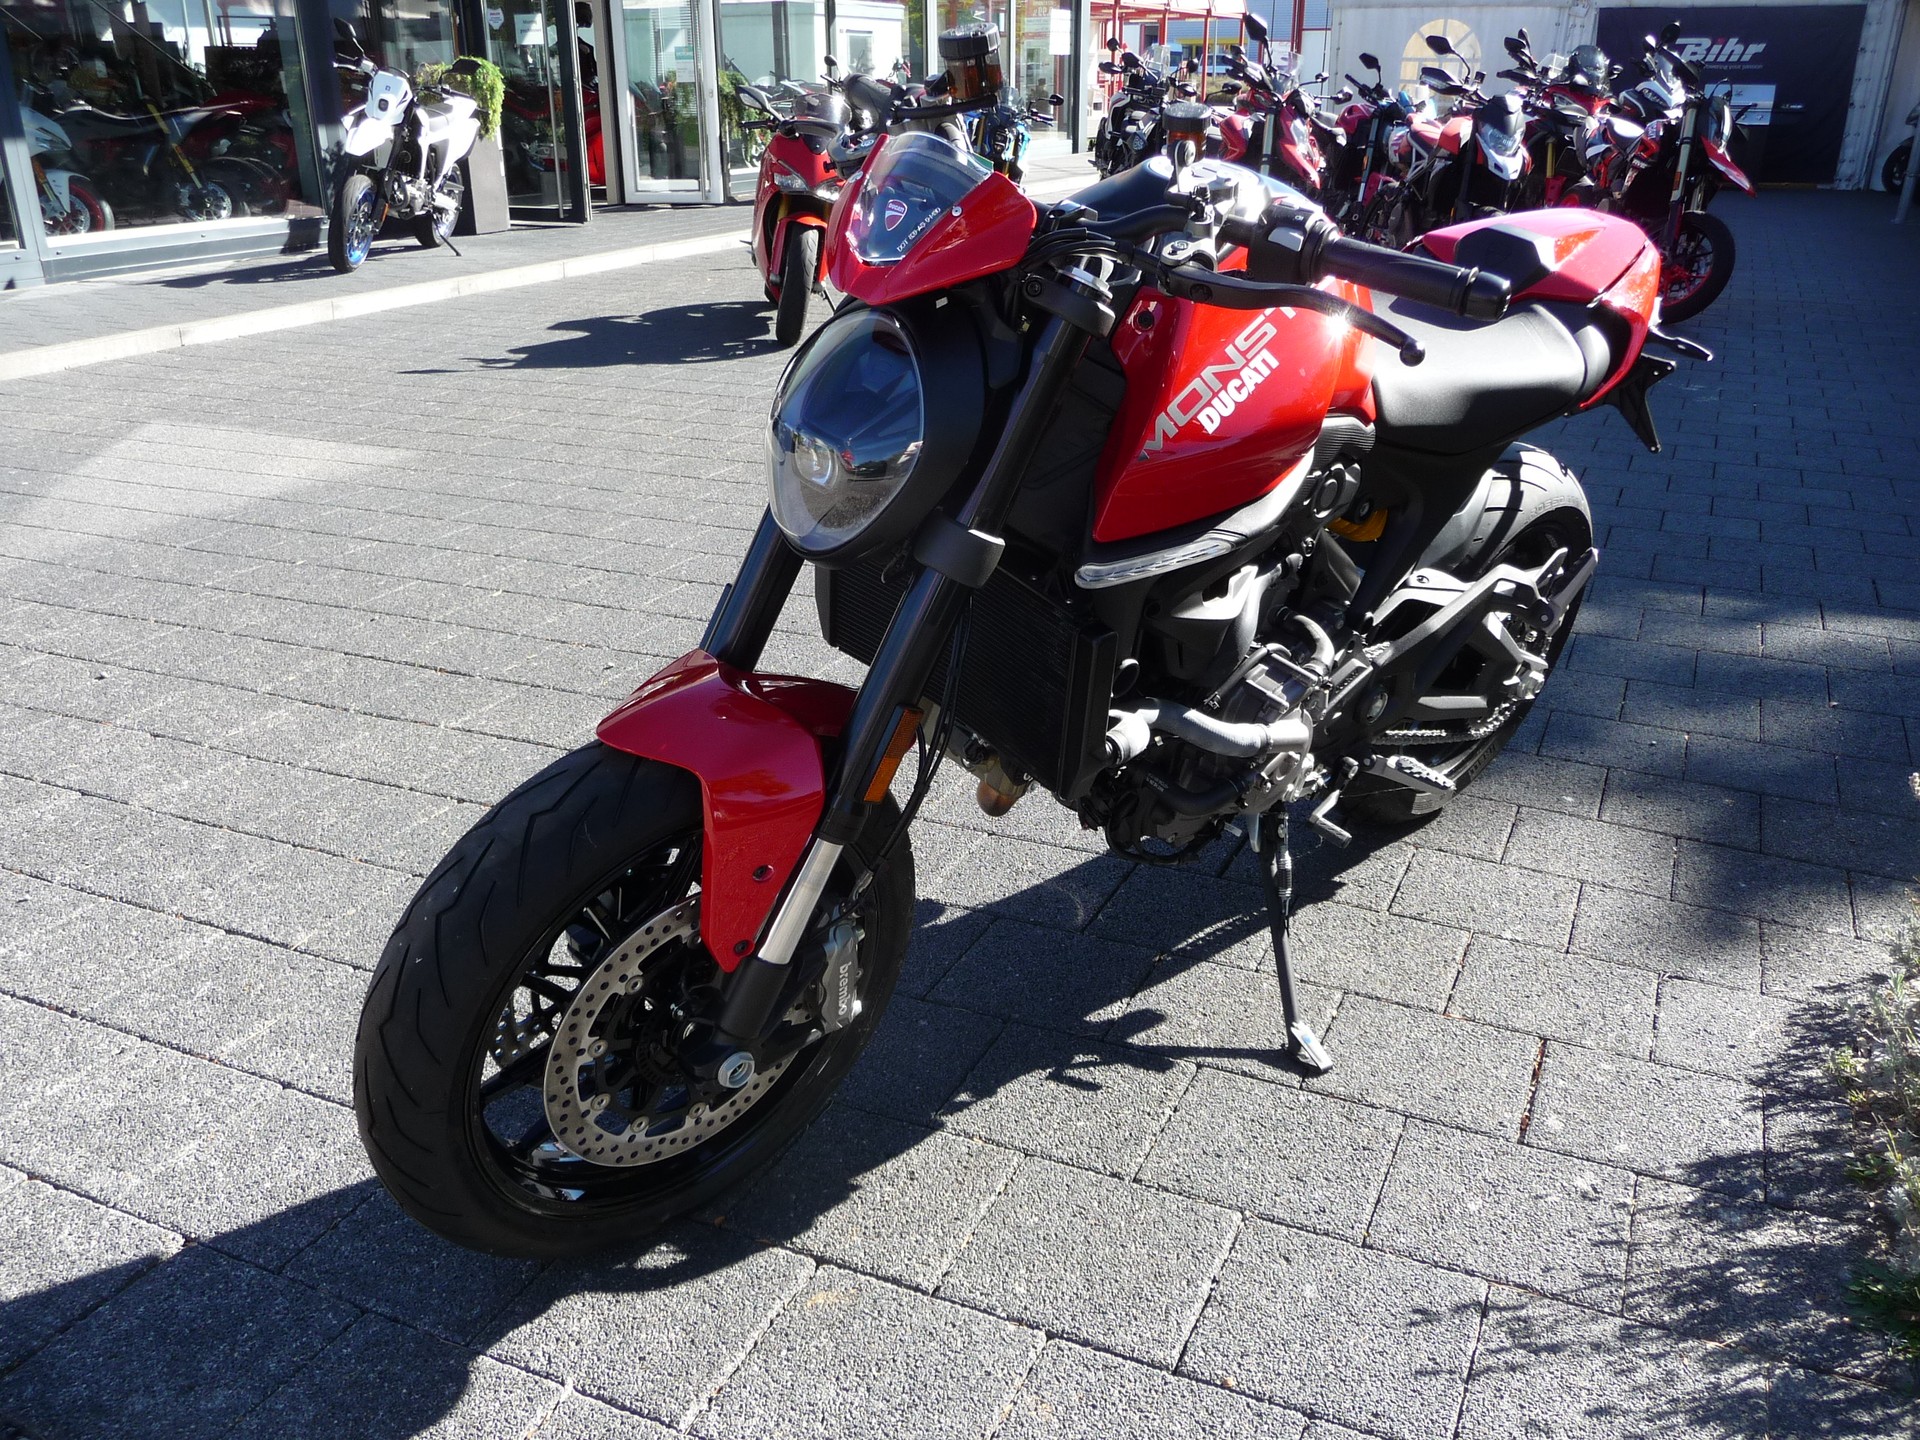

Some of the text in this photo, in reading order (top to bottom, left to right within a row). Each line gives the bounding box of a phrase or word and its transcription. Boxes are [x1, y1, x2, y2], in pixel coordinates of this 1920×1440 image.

[1675, 37, 1766, 62] Bihr
[888, 202, 905, 213] DUCATI
[896, 238, 909, 253] DOT
[1197, 348, 1280, 435] DUCATI
[838, 961, 851, 1015] brembo
